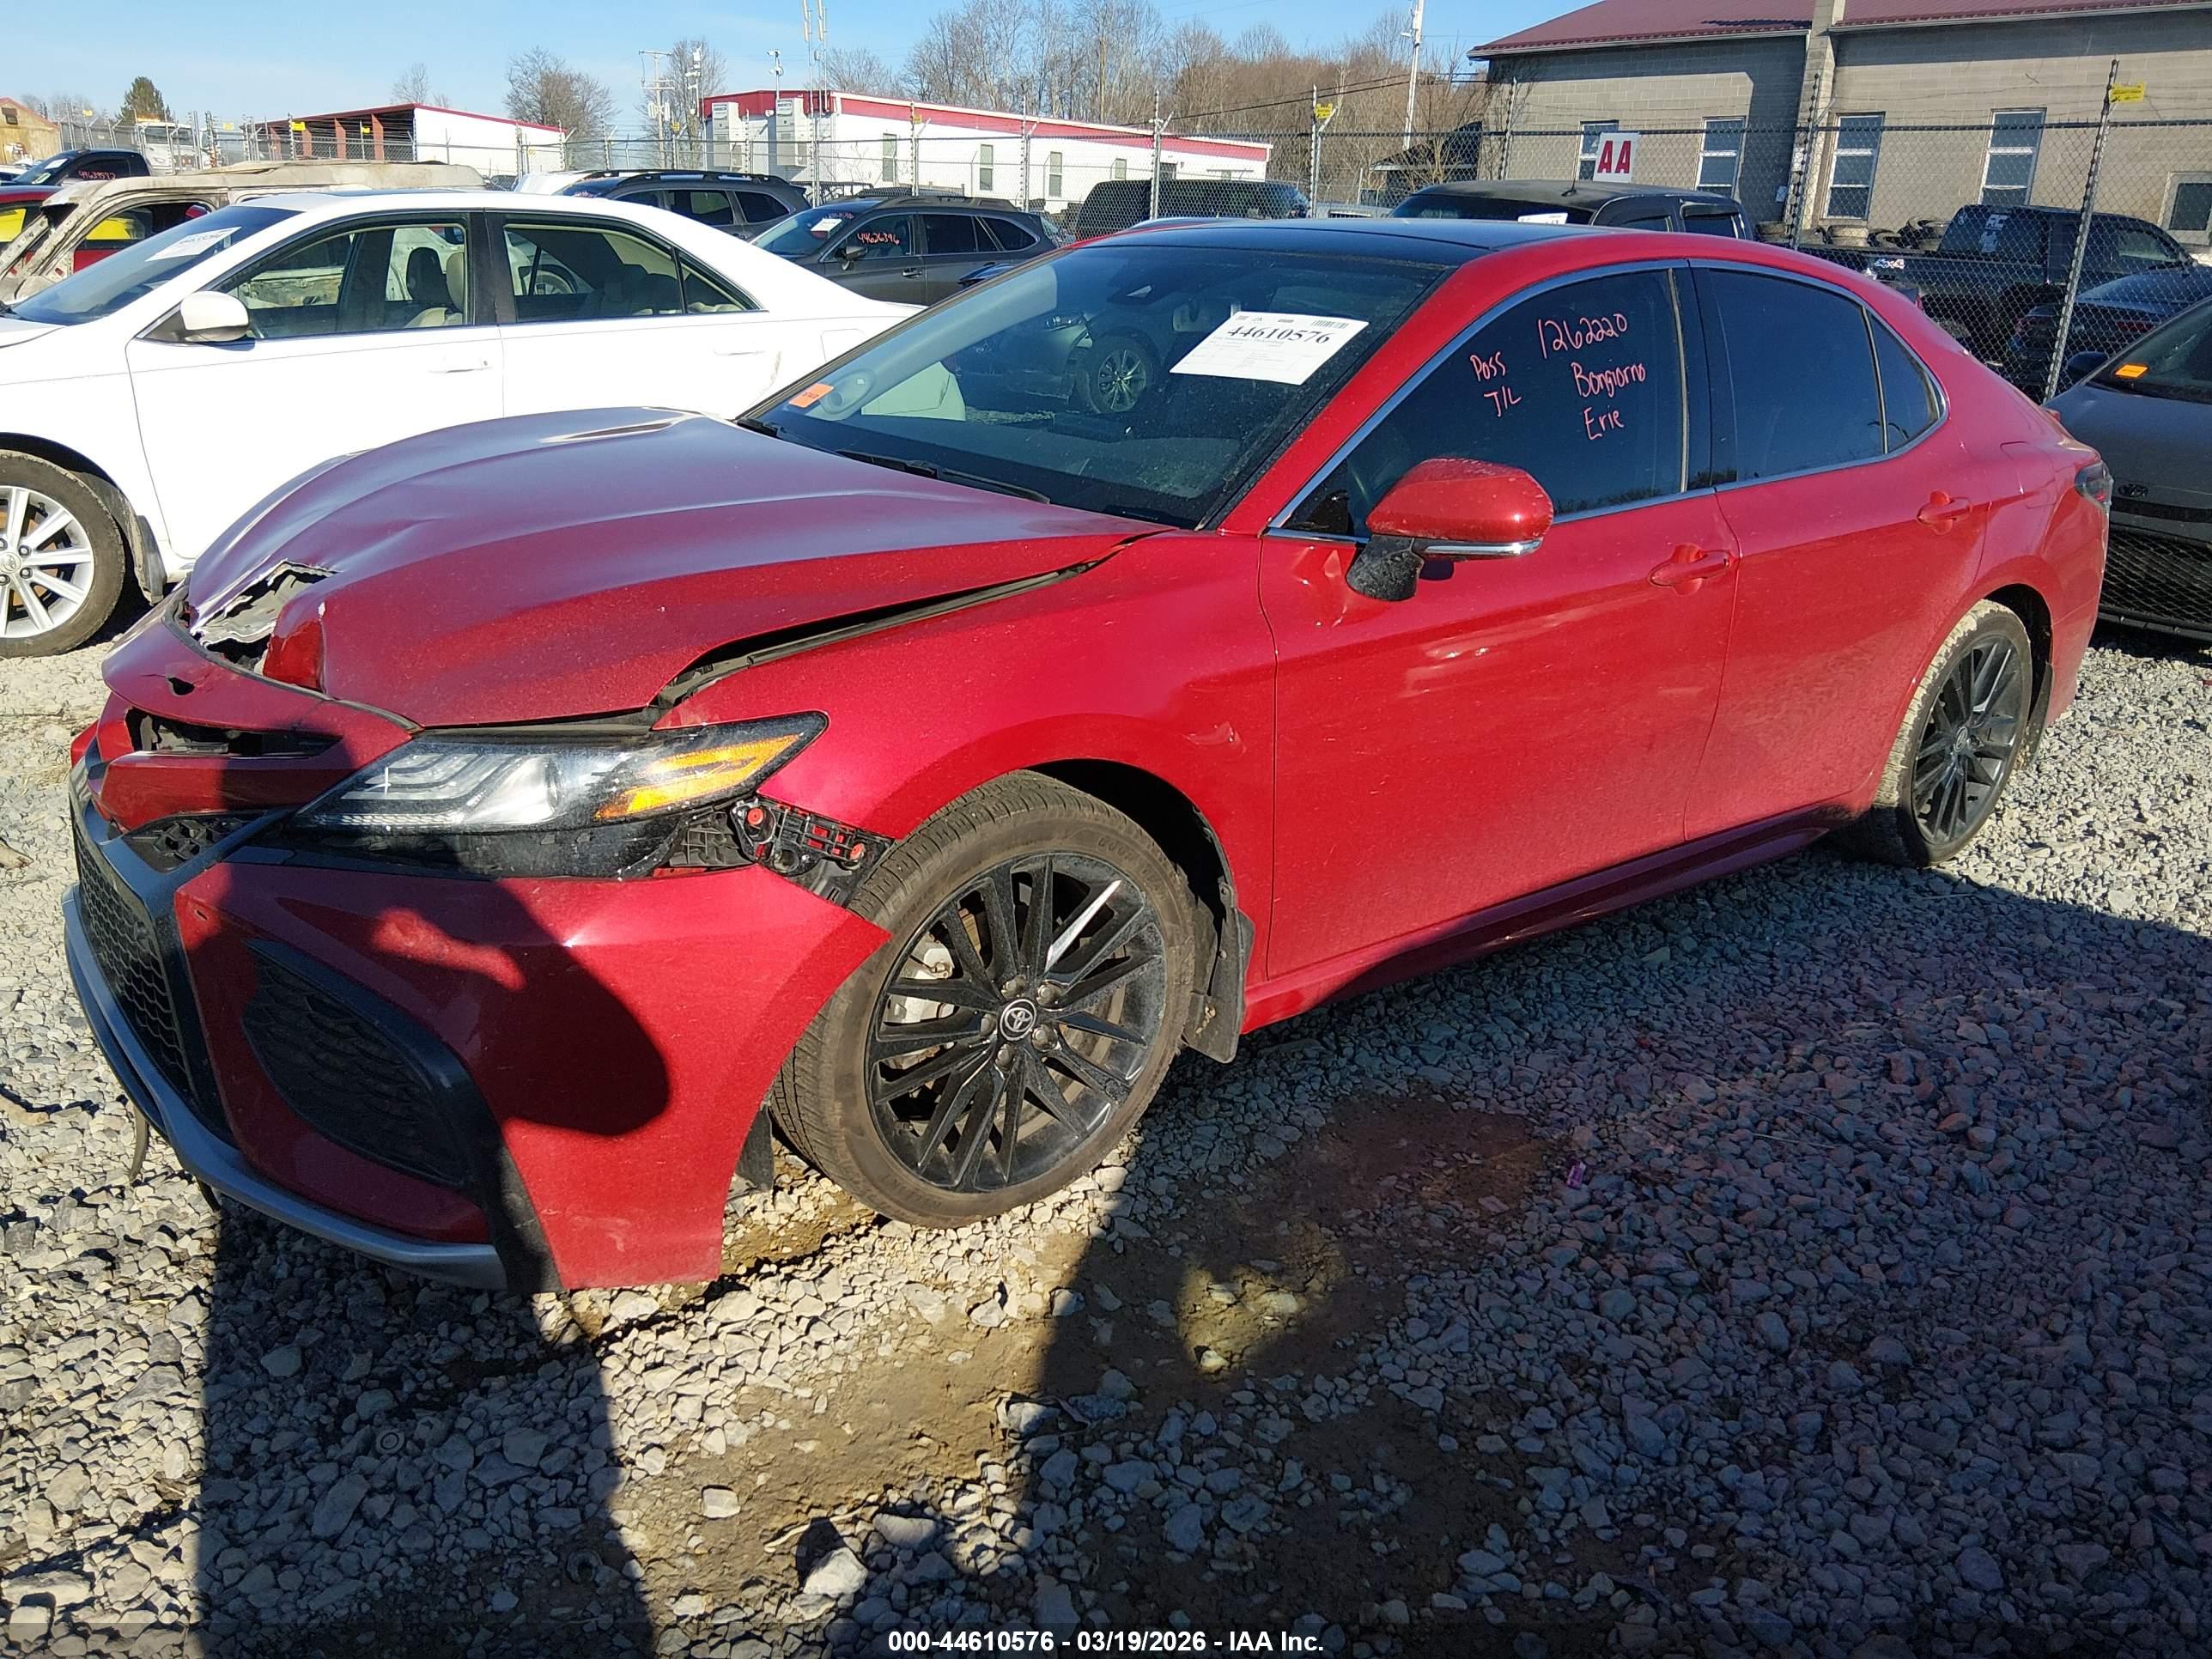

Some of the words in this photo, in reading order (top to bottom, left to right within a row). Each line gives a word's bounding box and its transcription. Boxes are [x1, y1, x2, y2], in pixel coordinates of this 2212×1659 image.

[1597, 140, 1632, 173] AA
[857, 233, 900, 245] 44626396
[1227, 325, 1334, 344] 44610576
[1536, 313, 1628, 359] 1262220
[1571, 362, 1646, 398] Bongiorno
[1583, 404, 1625, 440] Erie
